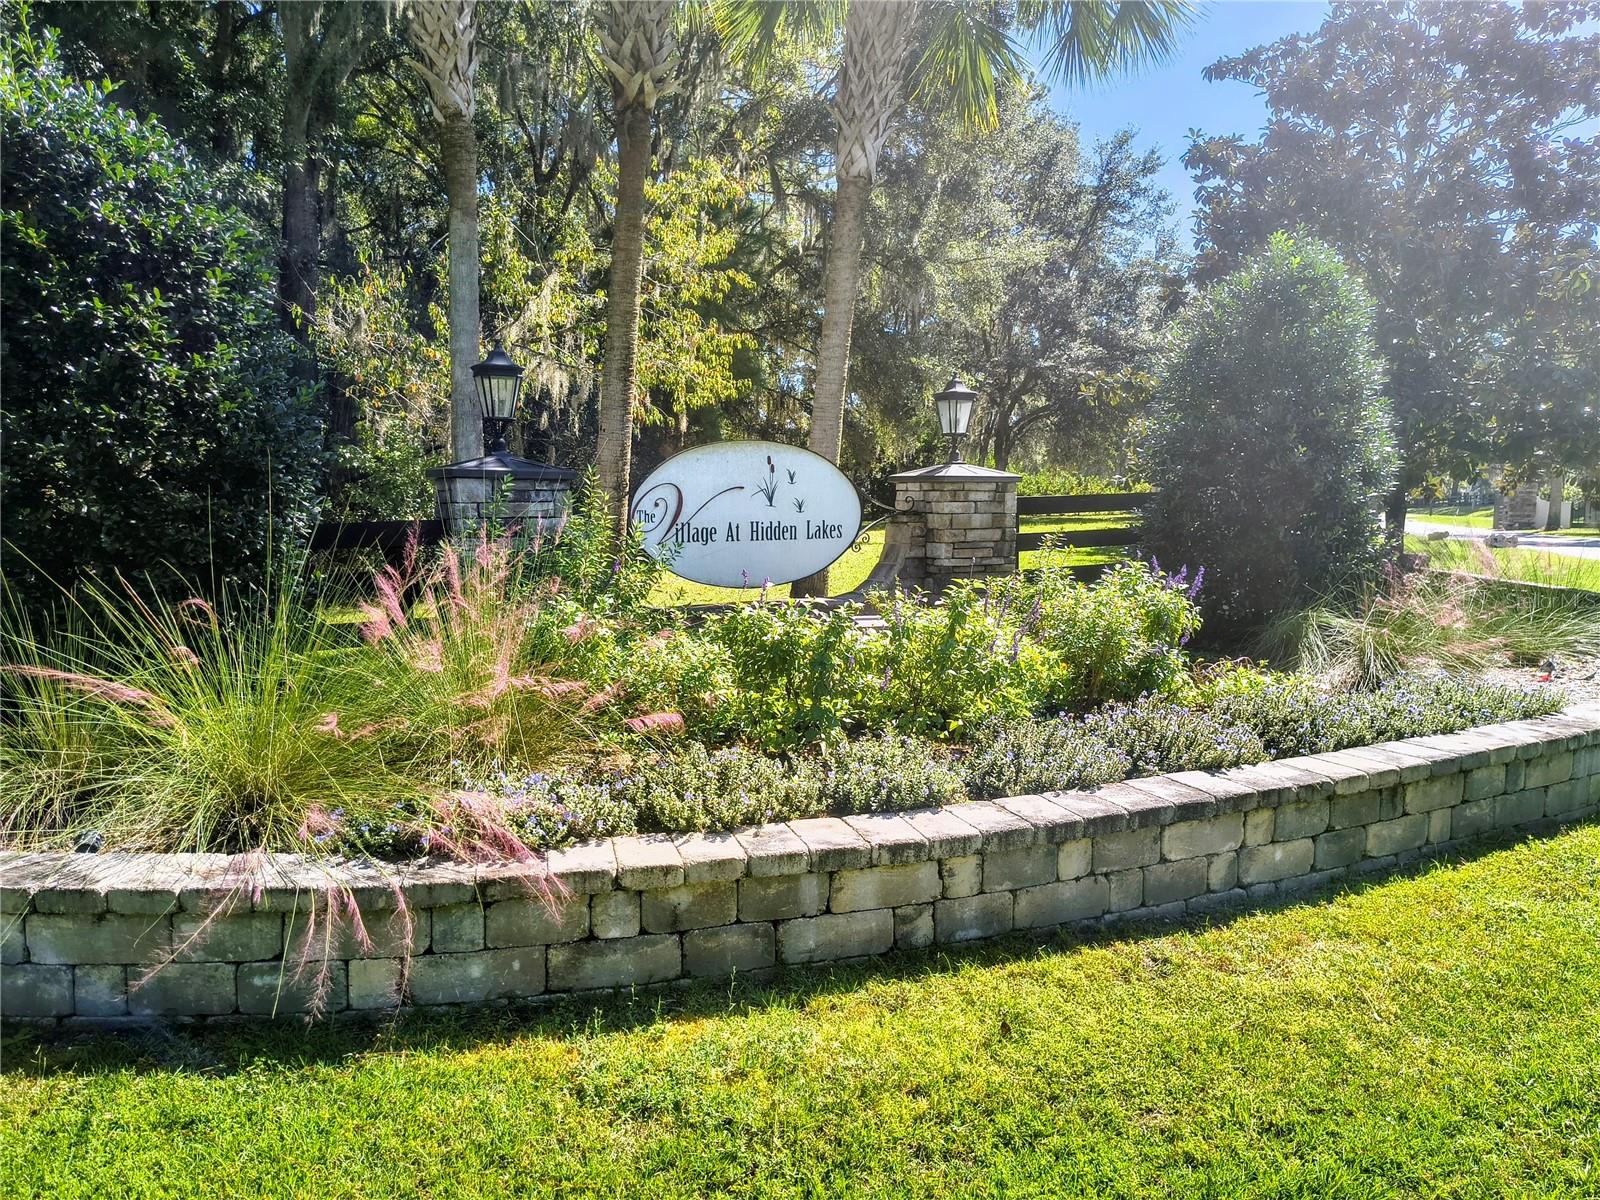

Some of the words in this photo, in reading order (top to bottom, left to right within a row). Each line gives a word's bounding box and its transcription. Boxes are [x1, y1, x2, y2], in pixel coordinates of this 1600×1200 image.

[631, 482, 722, 546] Village
[636, 509, 656, 524] The
[726, 521, 740, 542] At
[750, 520, 797, 541] Hidden
[806, 519, 843, 540] Lakes
